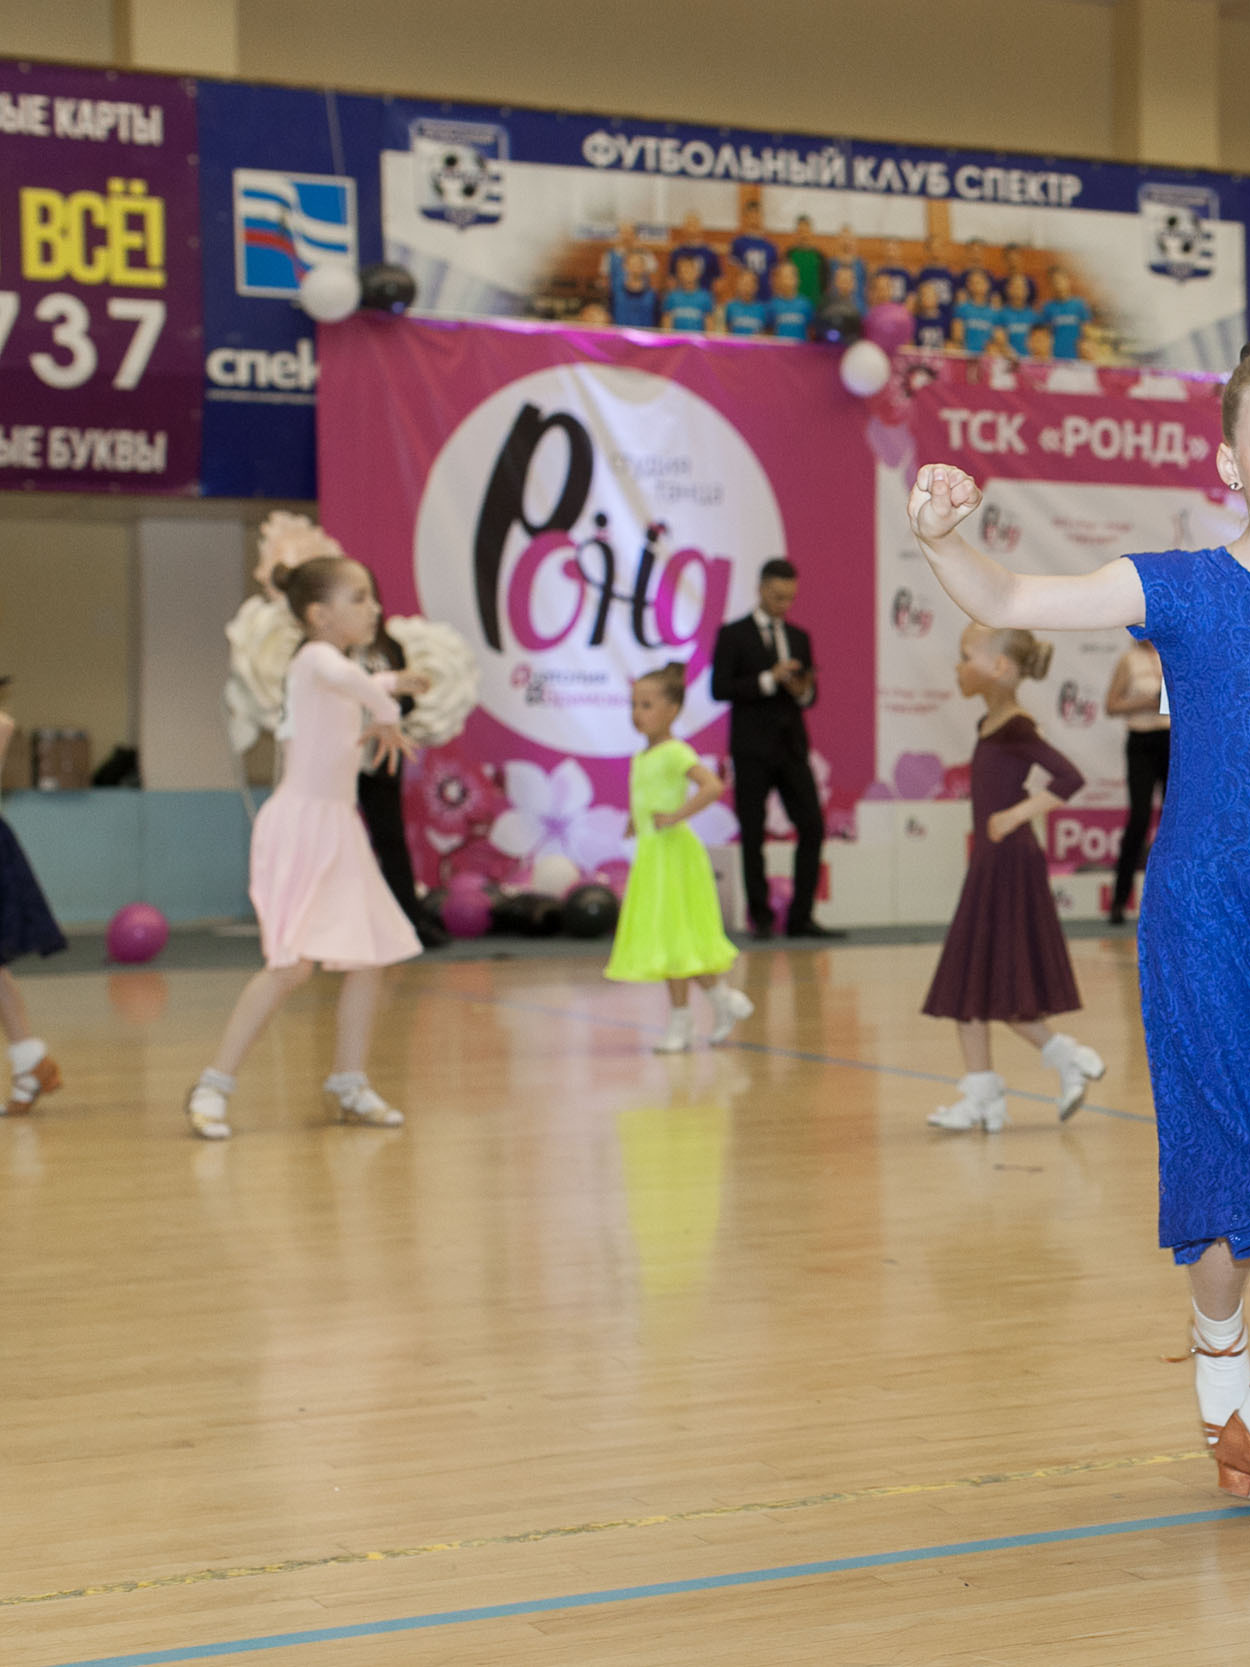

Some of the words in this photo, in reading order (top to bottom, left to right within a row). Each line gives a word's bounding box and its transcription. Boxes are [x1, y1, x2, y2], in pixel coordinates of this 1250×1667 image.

[54, 97, 164, 146] КАРТЫ
[582, 129, 847, 187] ФУТБОЛЬНЫЙ
[854, 156, 950, 197] КЛУБ
[954, 164, 1083, 206] СПЕКТР
[20, 176, 166, 289] ВСЁ!
[48, 426, 168, 474] БУКВЫ
[938, 408, 1028, 454] ТСК
